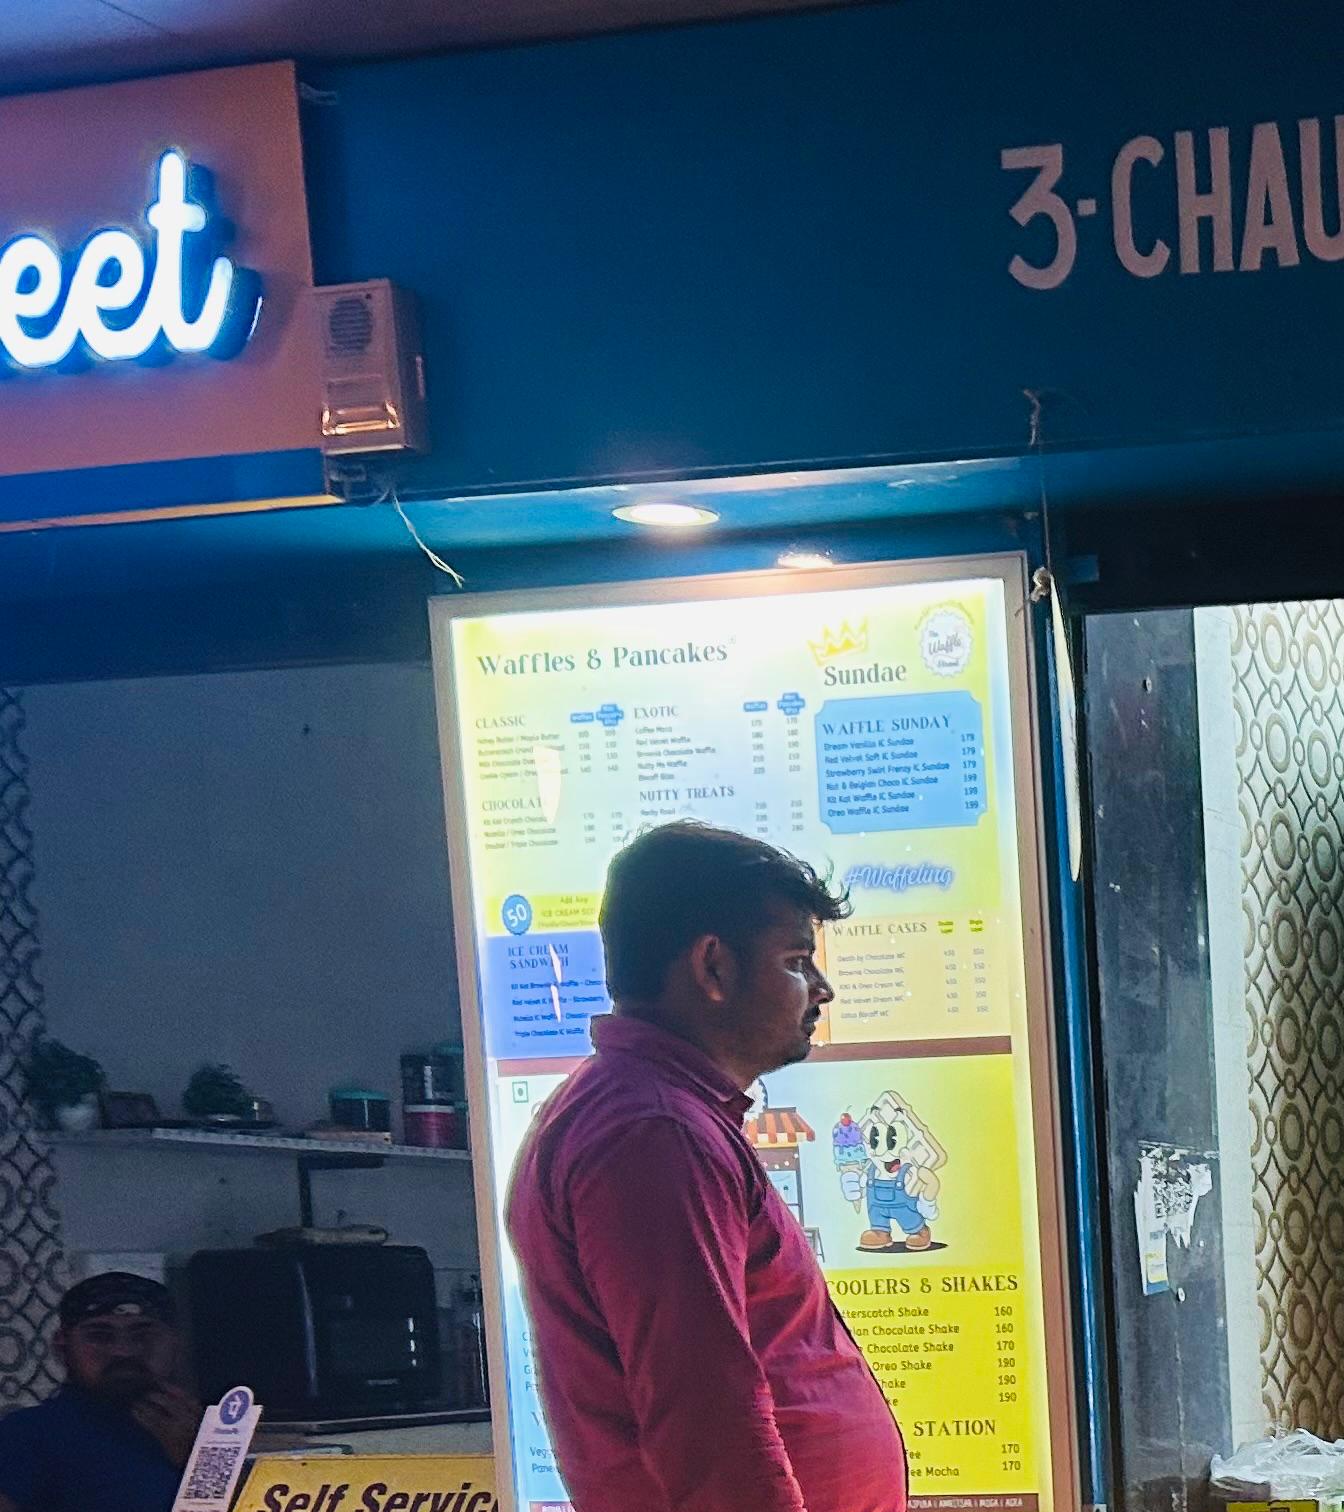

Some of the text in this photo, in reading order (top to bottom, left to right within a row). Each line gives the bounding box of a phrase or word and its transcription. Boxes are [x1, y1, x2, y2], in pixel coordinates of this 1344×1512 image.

[477, 641, 728, 676] Waffles & Pancakes
[824, 664, 907, 686] Sundae
[822, 714, 950, 735] WAFFLE SUNDAY
[639, 786, 734, 802] NUTTY TREATS
[507, 904, 527, 928] 50
[920, 1277, 932, 1294] &
[942, 1275, 1018, 1292] SHAKES
[867, 1341, 1015, 1354] Chocolate Shake 170
[872, 1358, 1016, 1371] Oreo Shake 190
[913, 1420, 996, 1437] STATION
[926, 1461, 1021, 1477] Mocha 170
